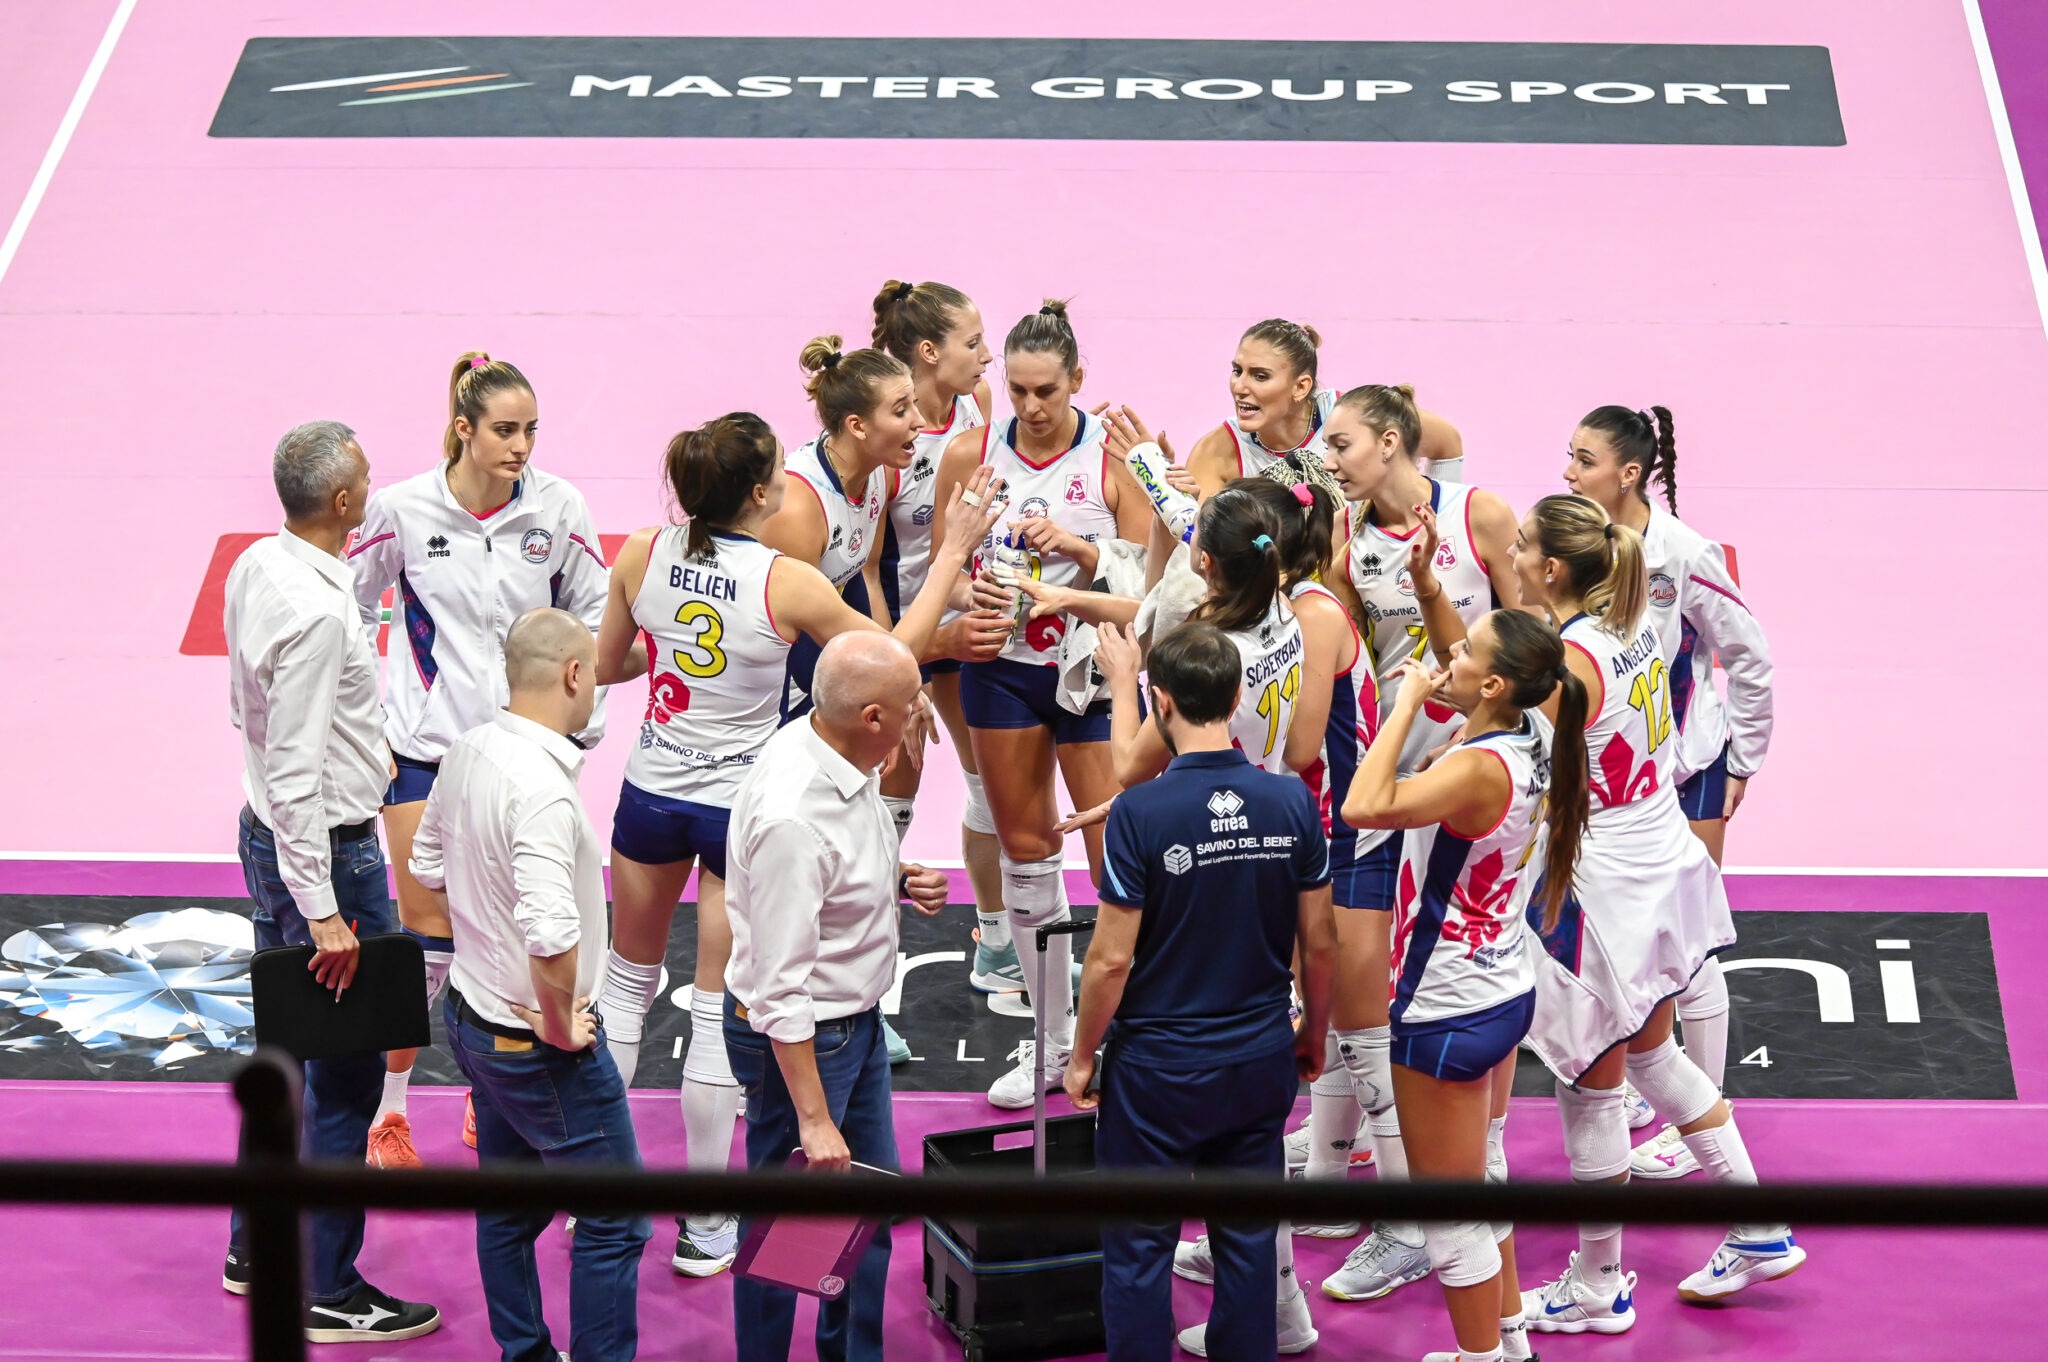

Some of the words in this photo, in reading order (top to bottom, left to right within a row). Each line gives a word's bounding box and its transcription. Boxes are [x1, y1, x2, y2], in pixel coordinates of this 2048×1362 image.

[569, 74, 1000, 99] MASTER
[1030, 76, 1413, 102] GROUP
[1445, 80, 1791, 105] SPORT
[914, 467, 935, 482] errea
[428, 549, 451, 558] errea
[669, 564, 737, 602] BELIEN
[1382, 606, 1418, 618] SAVINO
[1451, 597, 1472, 609] ENE
[673, 600, 728, 679] 3
[1262, 637, 1277, 650] errea
[1246, 628, 1302, 688] SCHERBAN
[1256, 661, 1300, 759] 11
[1627, 657, 1672, 755] 12
[655, 737, 694, 758] SAVINO
[695, 752, 718, 763] DEL
[1210, 815, 1249, 833] errea
[1196, 839, 1236, 855] SAVINO
[1238, 837, 1260, 849] DEL
[1263, 836, 1293, 847] BENE
[1197, 859, 1213, 867] Global
[1212, 856, 1233, 864] Logistics
[1244, 852, 1270, 860] Forwarding
